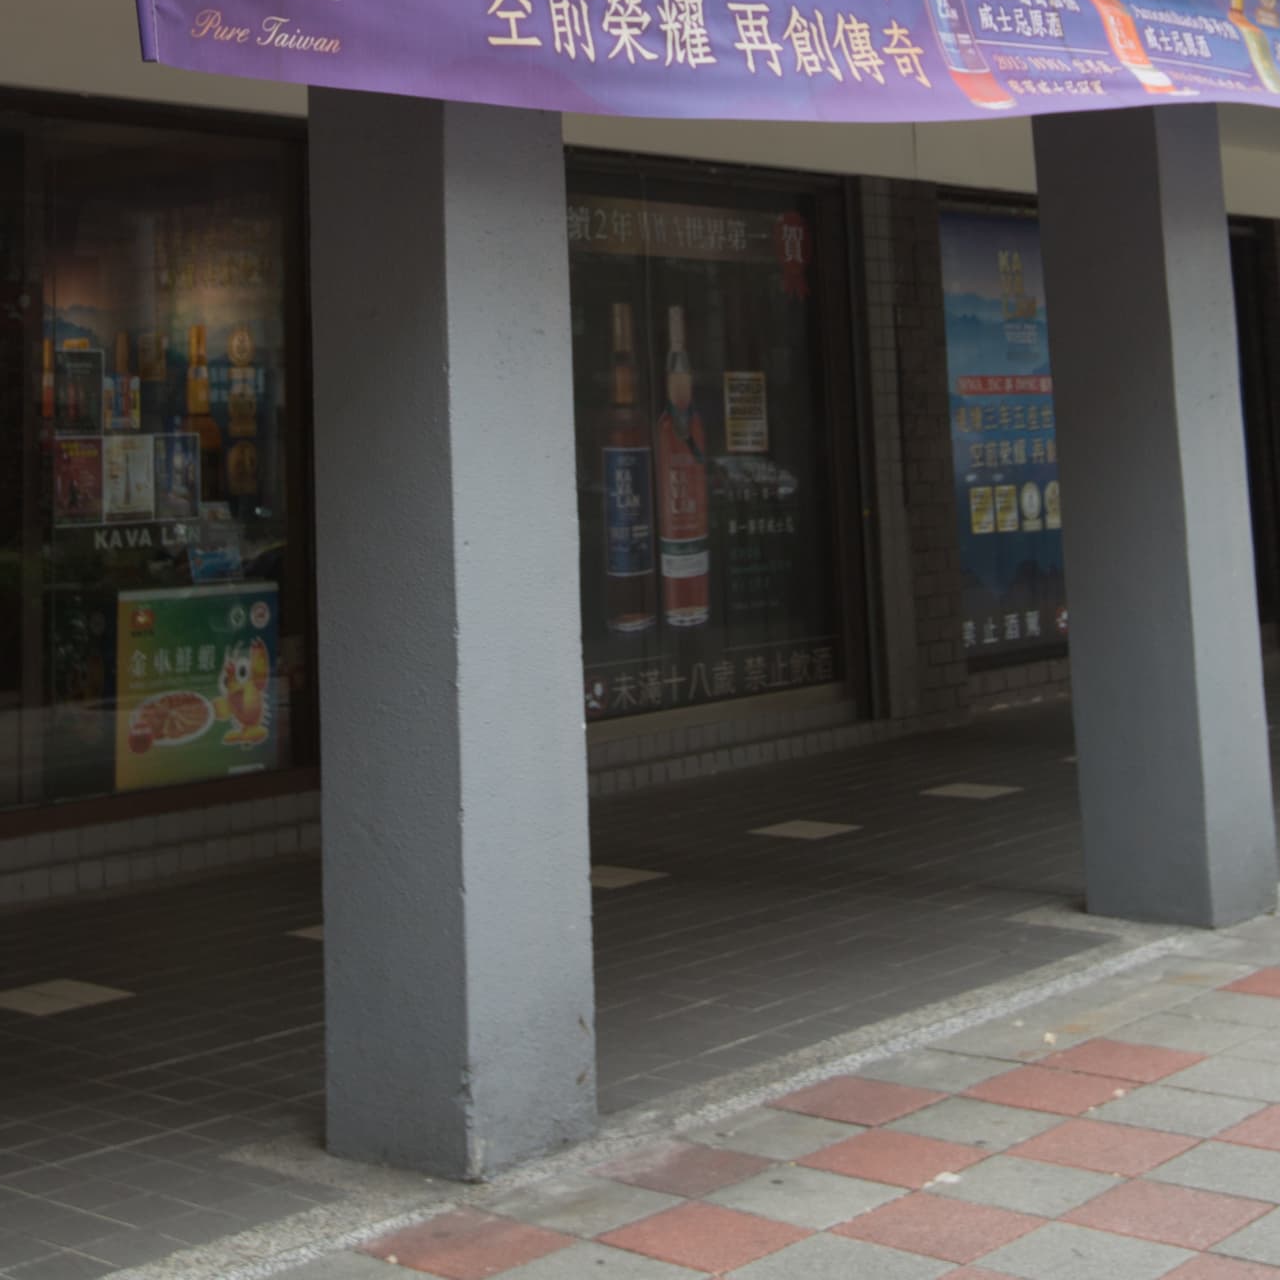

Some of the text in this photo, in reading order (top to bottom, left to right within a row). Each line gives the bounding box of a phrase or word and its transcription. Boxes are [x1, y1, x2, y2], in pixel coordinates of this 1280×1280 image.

[190, 8, 342, 54] Pure Taiwan
[978, 2, 1065, 38] 威士忌原酒
[726, 0, 933, 89] 再創傳奇
[782, 223, 804, 264] 賀
